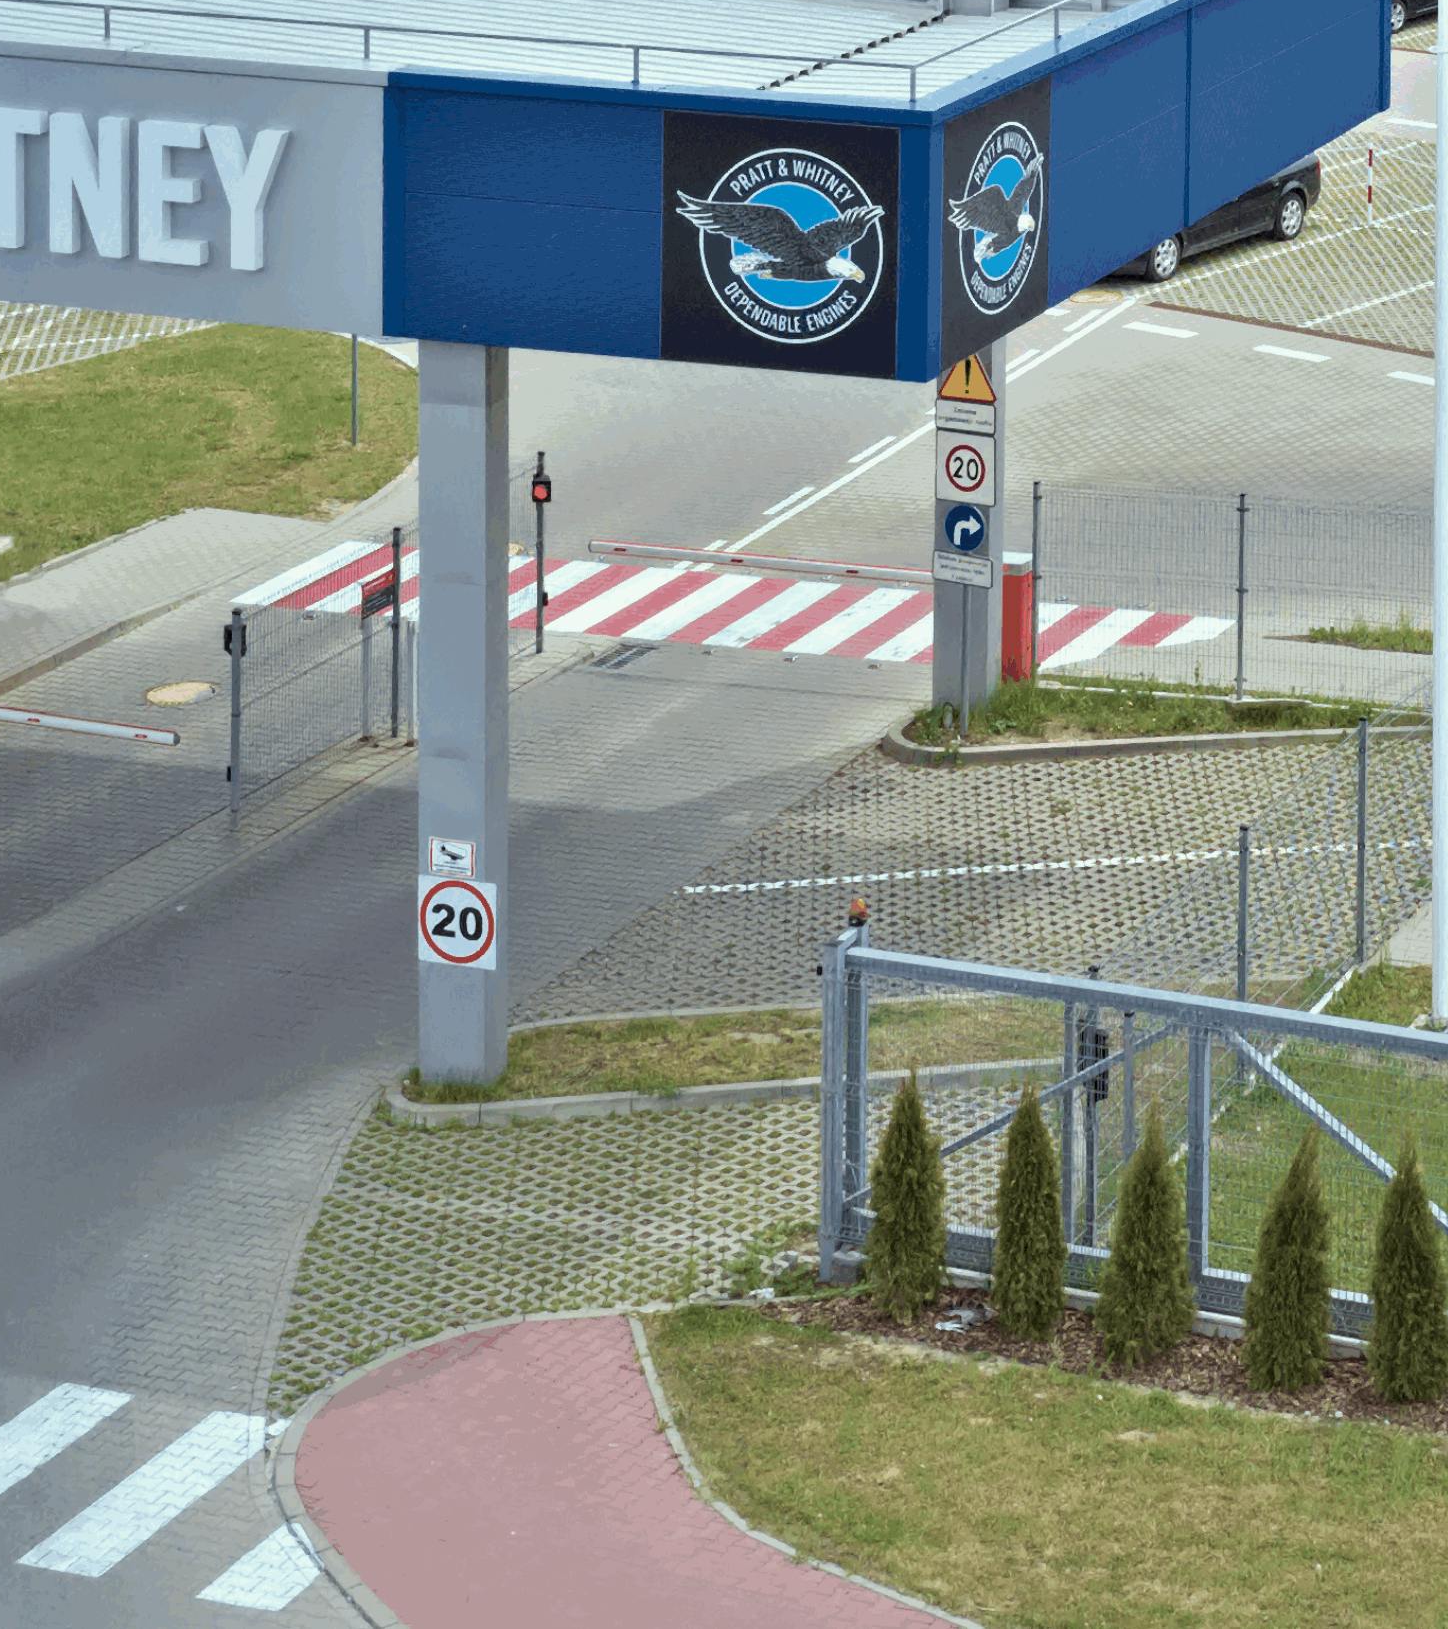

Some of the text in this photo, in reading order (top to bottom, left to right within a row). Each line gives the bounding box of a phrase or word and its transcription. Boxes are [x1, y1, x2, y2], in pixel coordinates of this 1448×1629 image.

[729, 158, 855, 204] PRATT & WHITNEY
[973, 131, 1032, 186] PRATT & WHITNEY
[970, 243, 1033, 303] DEPENDABLE ENGINES
[724, 279, 858, 334] DEPENDABLE ENGINES
[952, 456, 979, 481] 20
[431, 903, 483, 941] 20
